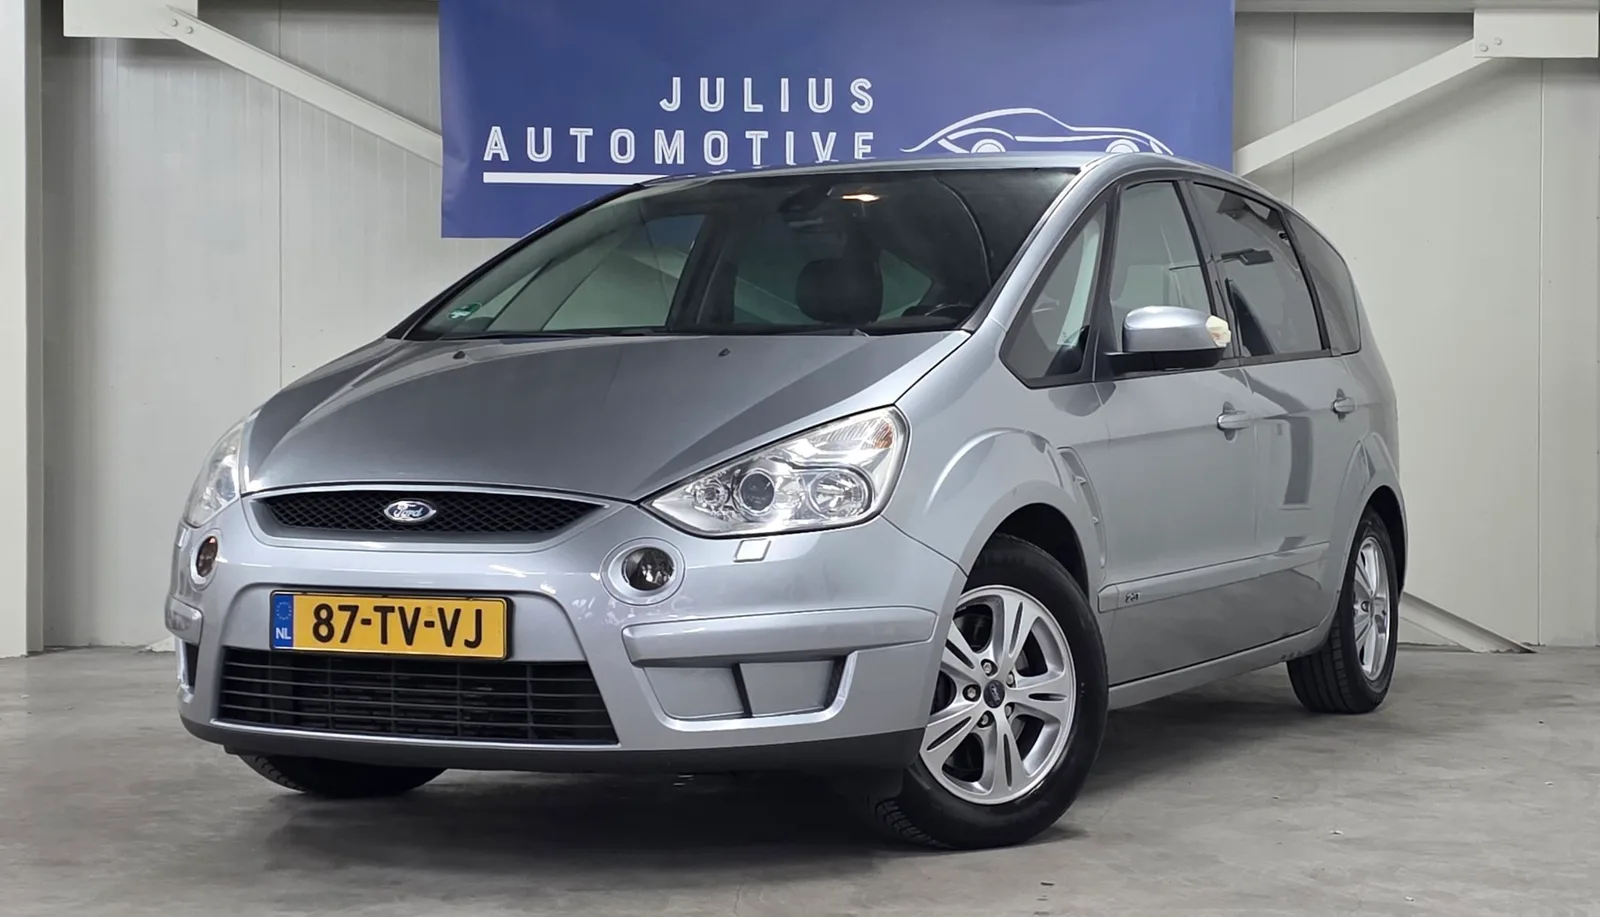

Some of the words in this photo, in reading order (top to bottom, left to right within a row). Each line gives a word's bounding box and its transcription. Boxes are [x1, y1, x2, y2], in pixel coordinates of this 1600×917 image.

[659, 77, 875, 114] JULIUS
[483, 126, 875, 166] AUTOMOTIVE
[393, 503, 424, 518] Ford
[275, 627, 292, 640] NL
[312, 603, 483, 649] 87-TV-VJ
